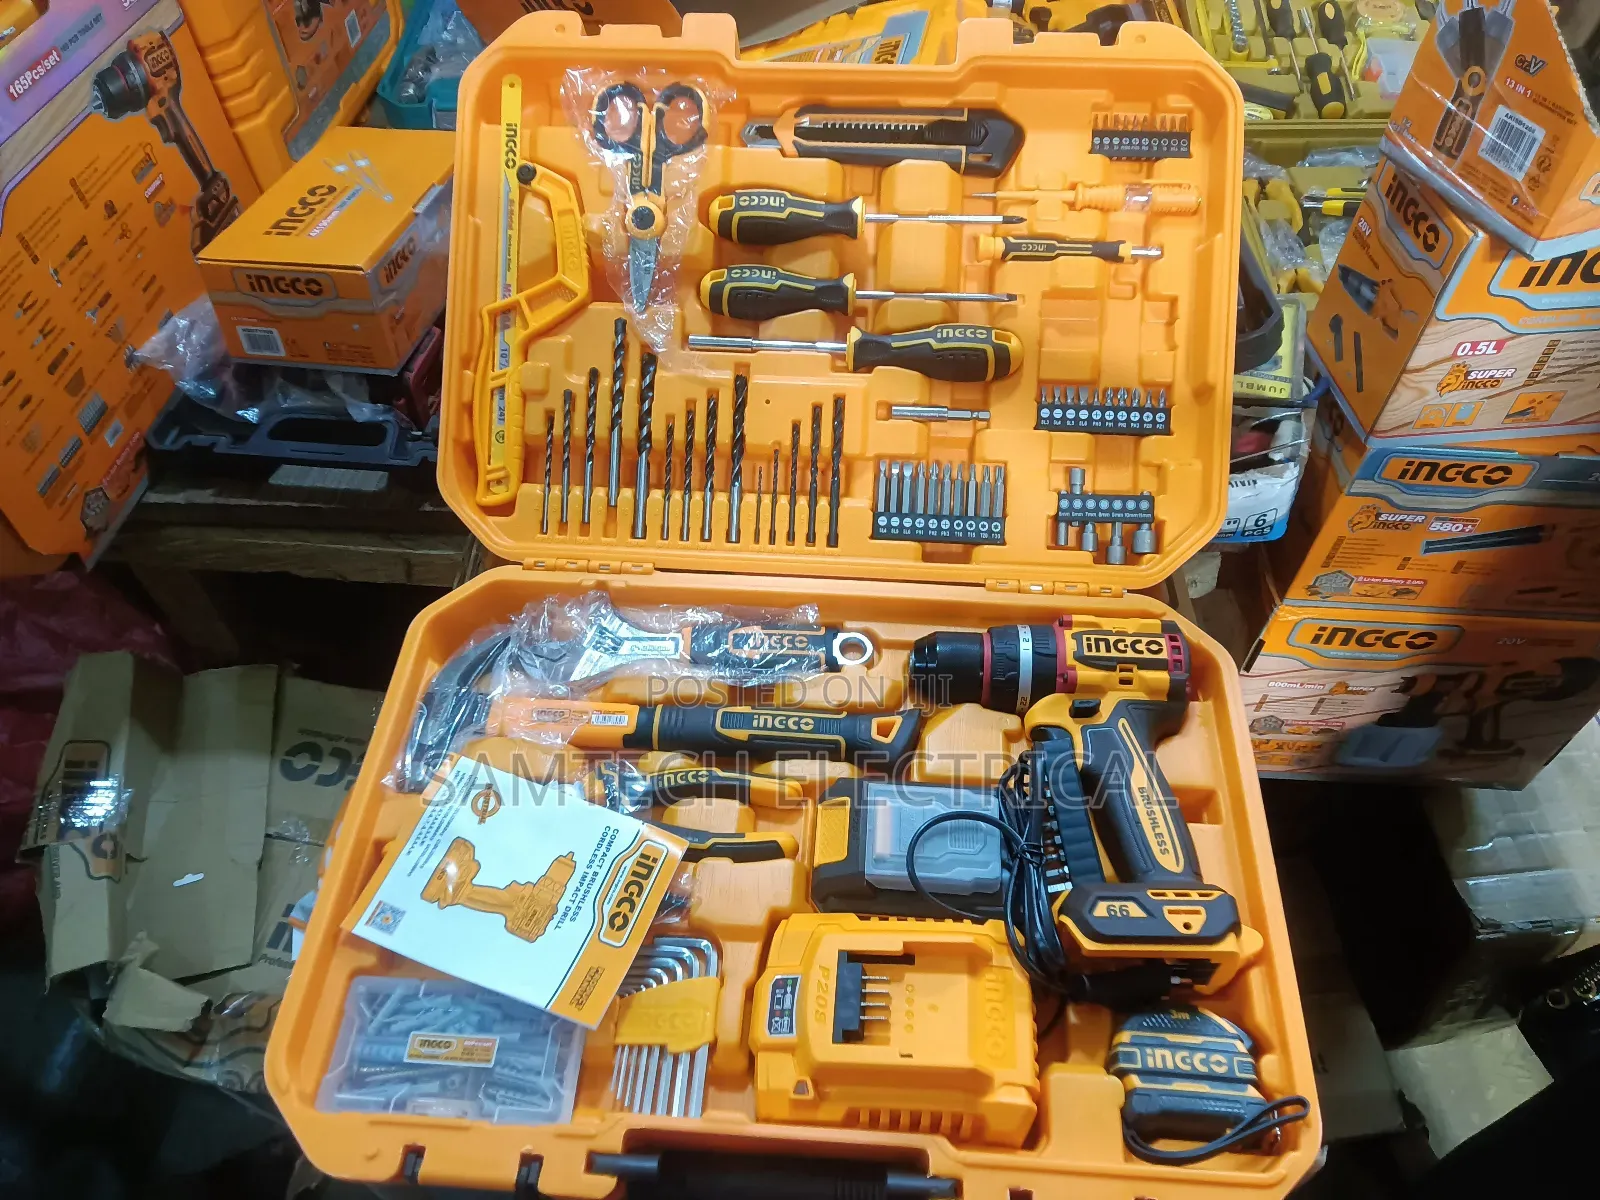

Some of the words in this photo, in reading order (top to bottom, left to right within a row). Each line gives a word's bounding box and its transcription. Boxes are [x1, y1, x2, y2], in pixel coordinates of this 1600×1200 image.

[8, 49, 61, 98] 165Pcs/set
[1505, 77, 1515, 89] 13
[1515, 85, 1526, 94] IN
[1526, 89, 1532, 98] 1
[1357, 216, 1373, 236] 20V
[1456, 341, 1499, 356] 0.5L
[1468, 369, 1516, 379] SUPER
[1255, 513, 1266, 528] 6
[1378, 513, 1426, 522] SUPER
[1428, 522, 1474, 532] 580+
[1244, 527, 1271, 537] PCS
[1138, 787, 1170, 856] BRUSHLESS
[586, 825, 611, 870] CORDLESS
[597, 828, 619, 869] COMPACT
[569, 871, 589, 905] IMPACT
[570, 871, 599, 922] BRUSHLESS
[554, 905, 571, 930] DRILL
